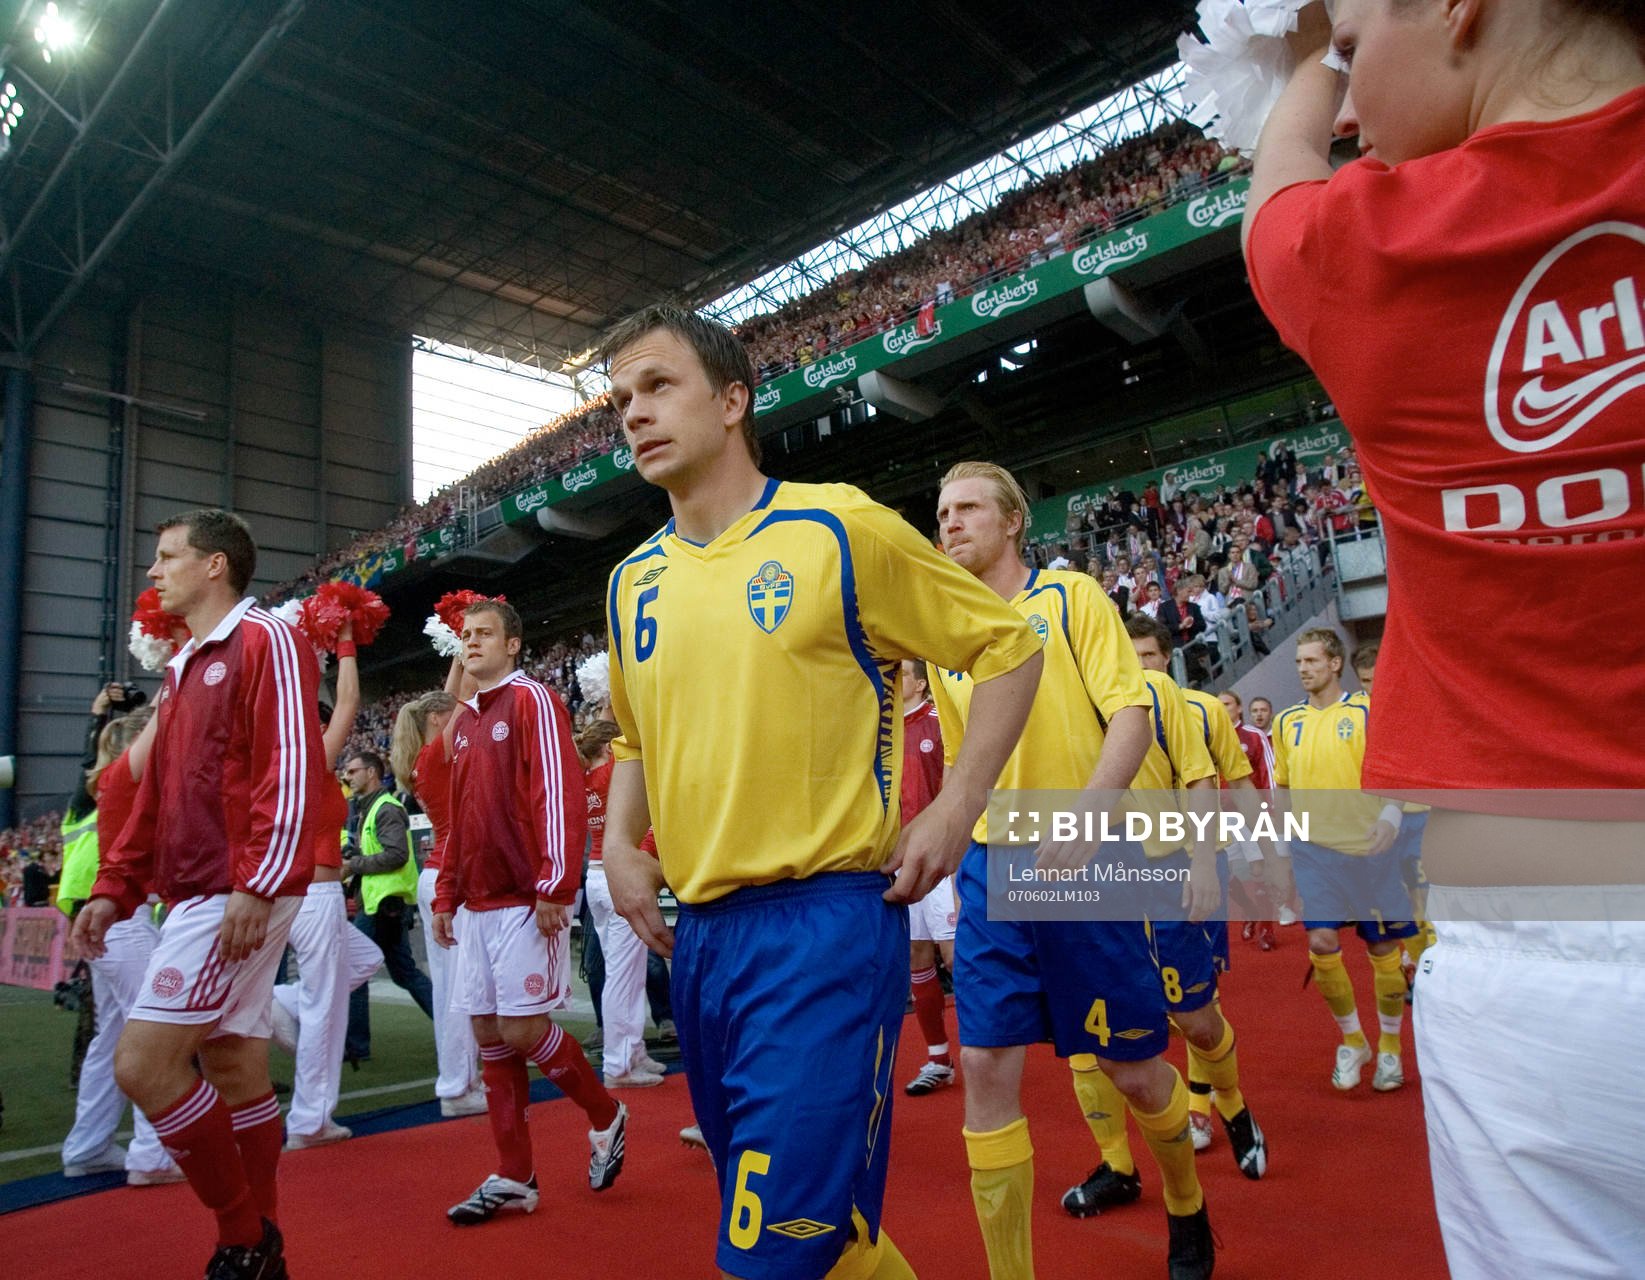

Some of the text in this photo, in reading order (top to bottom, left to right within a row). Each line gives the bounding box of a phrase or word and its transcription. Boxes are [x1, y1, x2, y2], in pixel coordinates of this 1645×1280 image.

[1186, 188, 1249, 227] Carlsbe
[1072, 232, 1148, 275] Carlsberg
[971, 279, 1038, 317] Carlsberg
[883, 320, 942, 354] Carlsbg
[1522, 276, 1645, 373] Arl
[804, 355, 857, 388] Carlsberg
[562, 468, 597, 491] Carlsberg
[1441, 463, 1645, 532] DO
[516, 490, 548, 511] Carlsberg
[635, 585, 659, 663] 6
[1293, 721, 1303, 746] 7
[1162, 966, 1183, 1003] 8
[1084, 998, 1111, 1047] 4
[729, 1149, 771, 1250] 6
